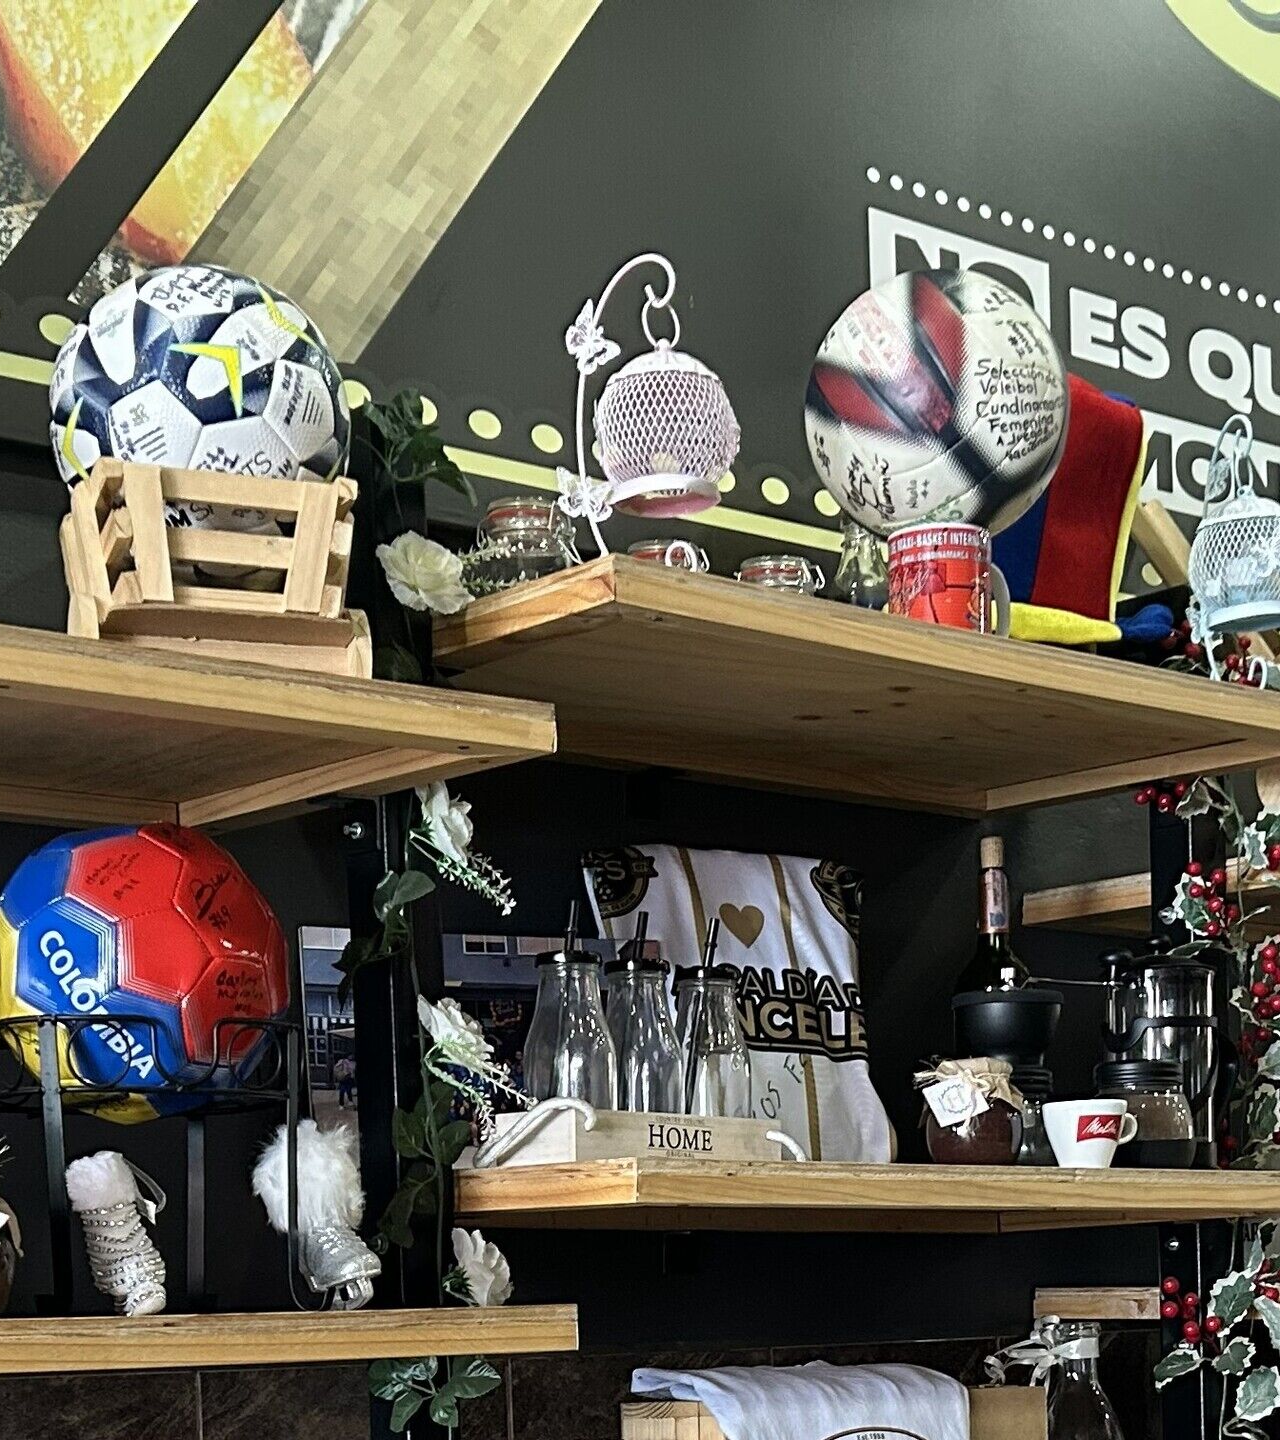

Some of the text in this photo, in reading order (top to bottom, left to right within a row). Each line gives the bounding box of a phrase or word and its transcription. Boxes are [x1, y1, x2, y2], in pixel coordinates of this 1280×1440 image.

[1069, 287, 1171, 380] ES
[39, 928, 156, 1081] COLOMBIA
[648, 1123, 713, 1151] HOME
